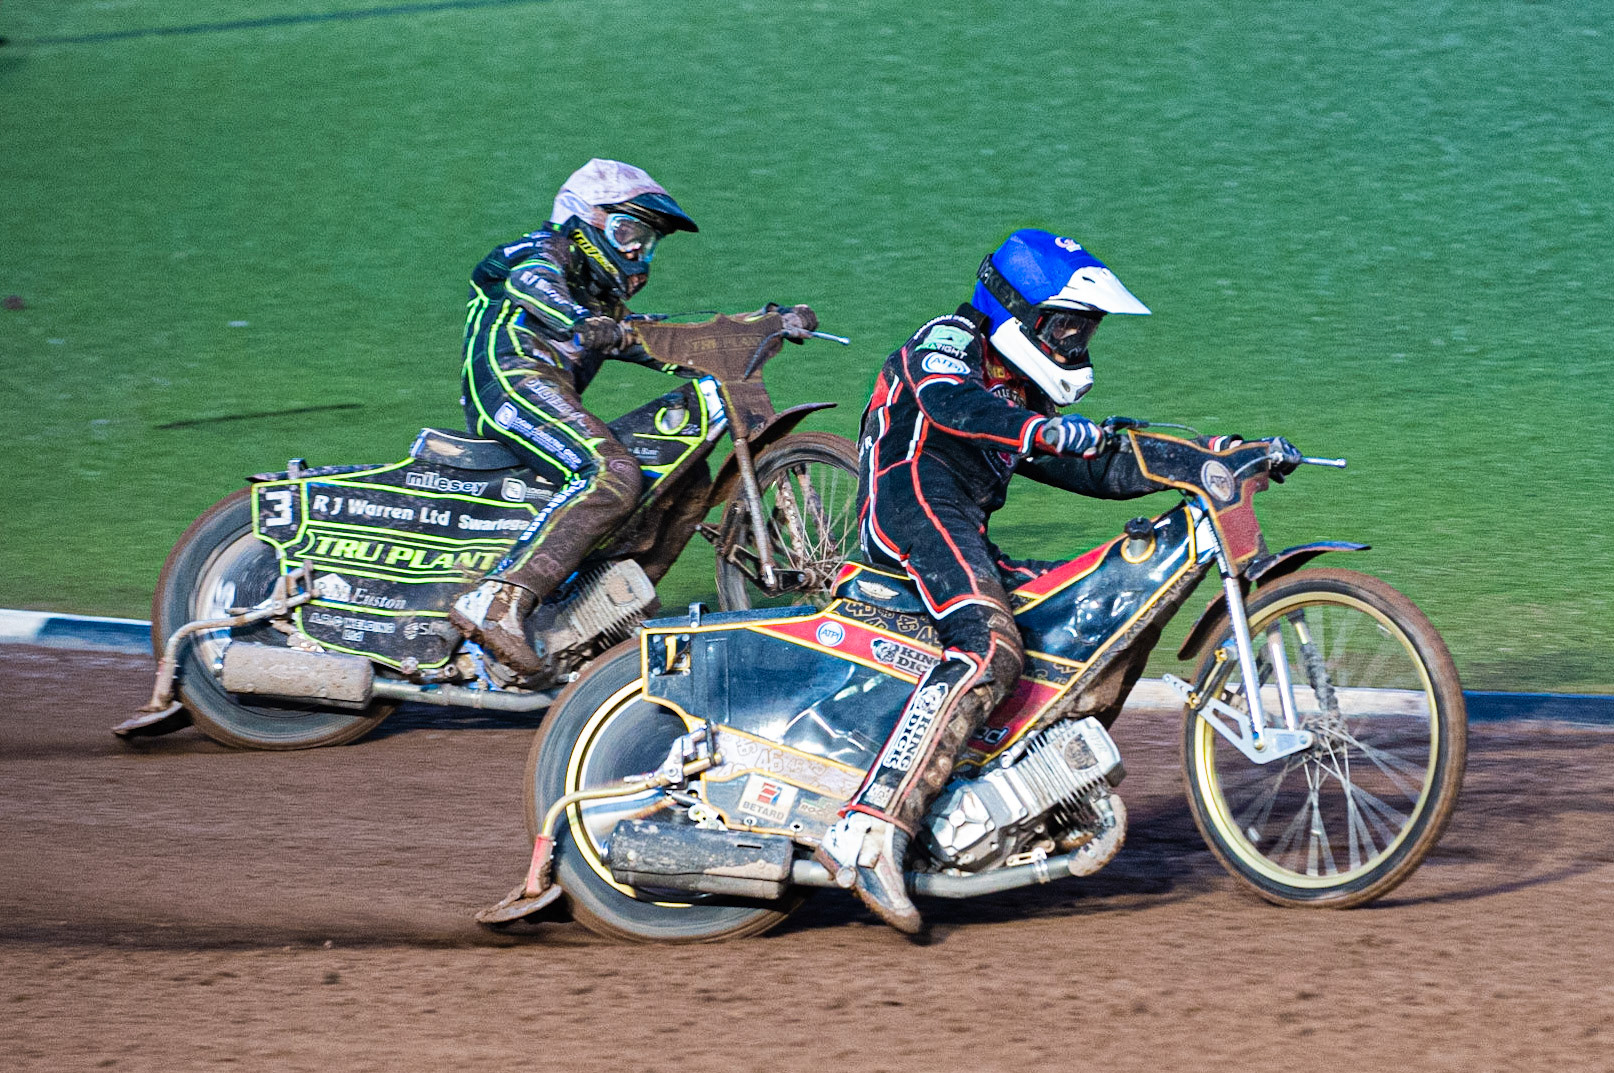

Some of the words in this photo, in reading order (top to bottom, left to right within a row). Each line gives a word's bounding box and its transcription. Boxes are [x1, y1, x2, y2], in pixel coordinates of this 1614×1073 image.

[405, 471, 489, 496] milesey
[265, 490, 293, 527] 3
[348, 498, 415, 521] Warren
[419, 506, 451, 526] Ltd
[314, 536, 385, 562] TRU
[384, 549, 499, 571] PLANT
[351, 587, 407, 610] Euston
[896, 655, 932, 673] DIC
[886, 712, 921, 767] DICK
[898, 715, 932, 770] KING
[742, 801, 785, 820] BETARD
